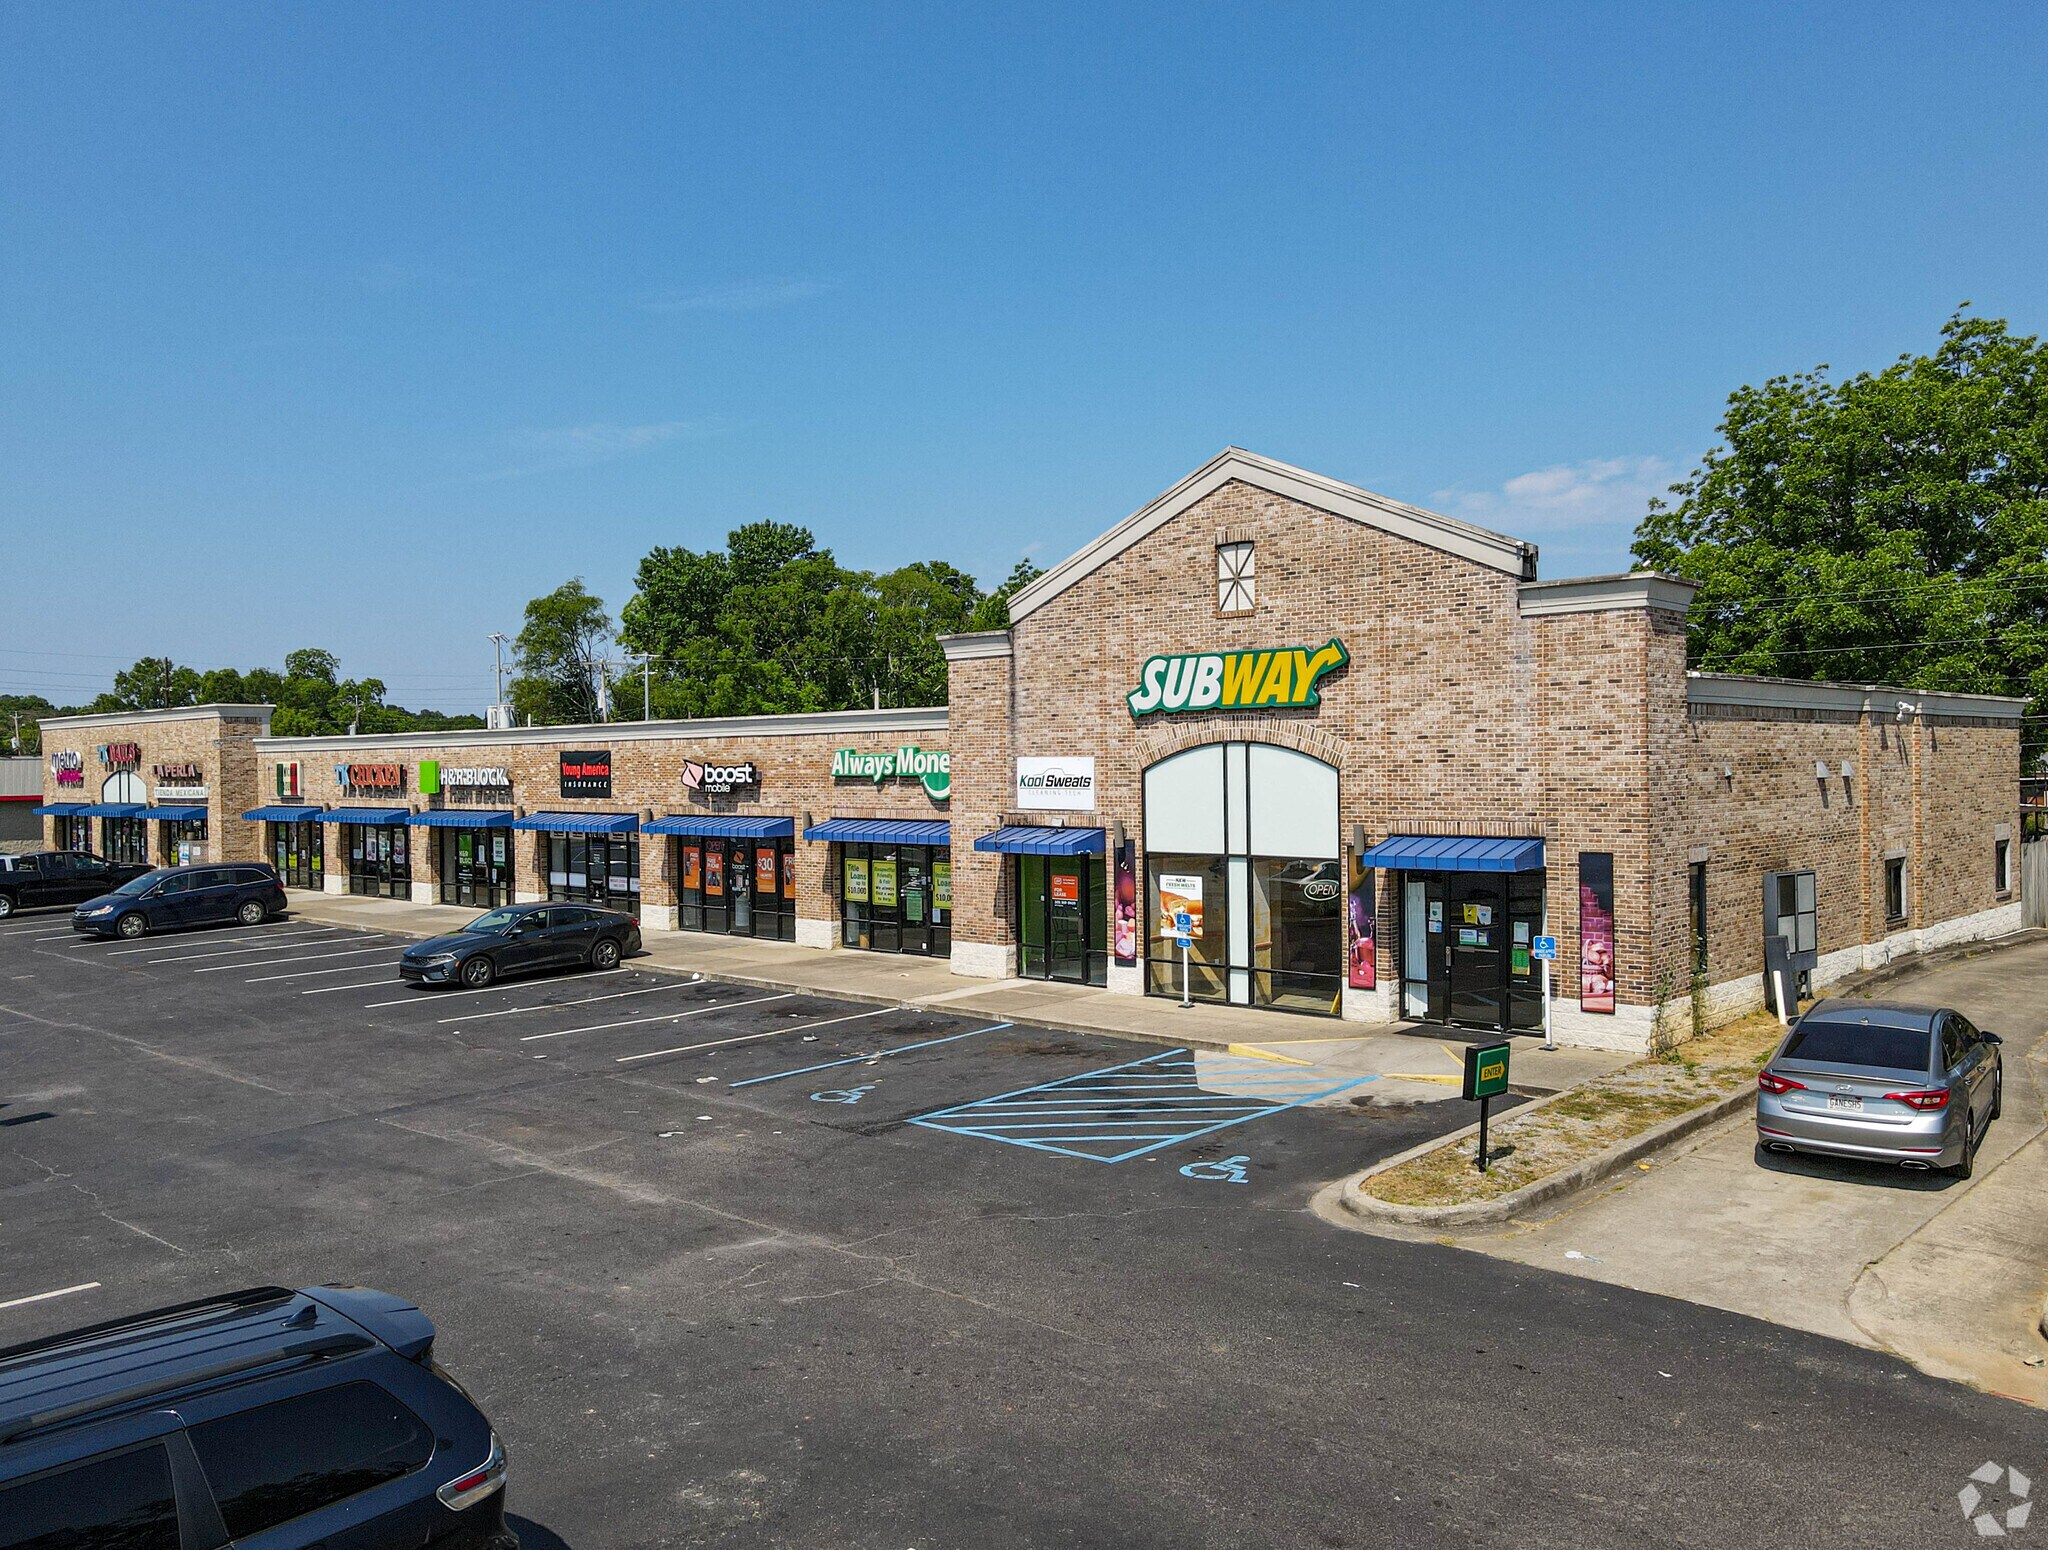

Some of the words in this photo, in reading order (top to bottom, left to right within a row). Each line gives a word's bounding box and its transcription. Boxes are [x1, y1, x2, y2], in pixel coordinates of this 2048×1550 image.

[1129, 643, 1343, 713] SUBWAY
[52, 747, 78, 769] metro
[97, 745, 108, 762] TK
[165, 764, 195, 778] PERLA
[562, 762, 581, 779] Young
[582, 763, 609, 776] America
[704, 763, 753, 784] boost
[831, 750, 893, 782] Always
[335, 764, 350, 785] TK
[351, 765, 400, 787] CHICKEN
[440, 768, 464, 786] H&R
[463, 768, 507, 786] BLOCK
[1020, 774, 1045, 787] Kool
[1045, 775, 1092, 788] Sweats
[175, 789, 204, 797] MEXICANA
[705, 784, 731, 793] mobile
[757, 858, 773, 871] $30
[851, 872, 867, 880] Loans
[1309, 884, 1337, 896] OPEN
[1484, 1066, 1502, 1078] ENTER
